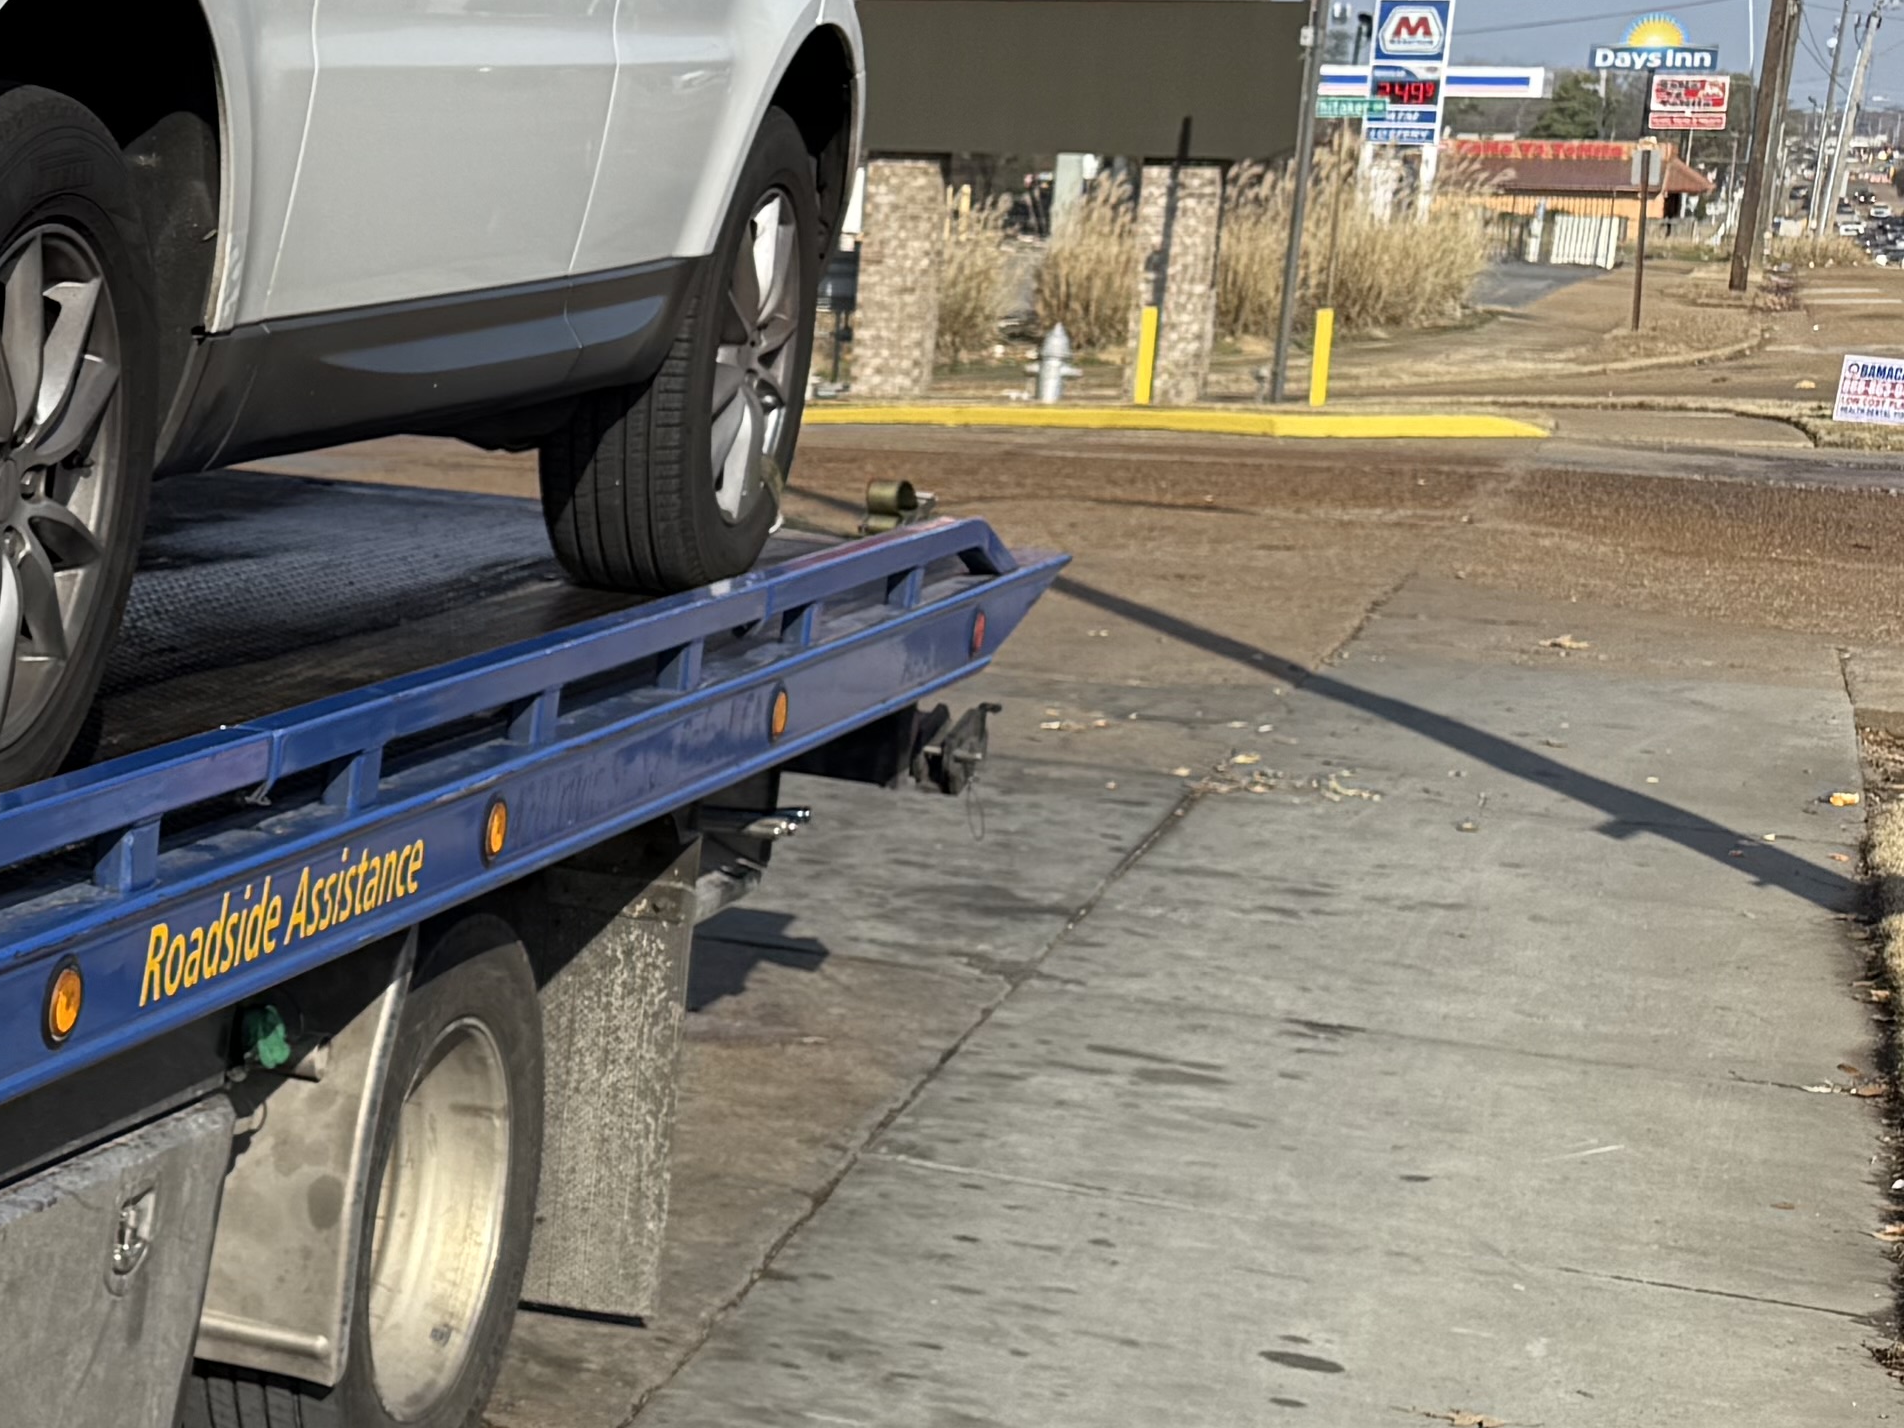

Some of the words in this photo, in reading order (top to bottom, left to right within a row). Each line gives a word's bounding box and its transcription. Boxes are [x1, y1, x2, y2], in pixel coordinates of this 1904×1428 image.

[1595, 48, 1662, 70] Days
[1666, 49, 1711, 67] Inn
[139, 876, 282, 1007] Roadside
[284, 839, 424, 946] Assistance
